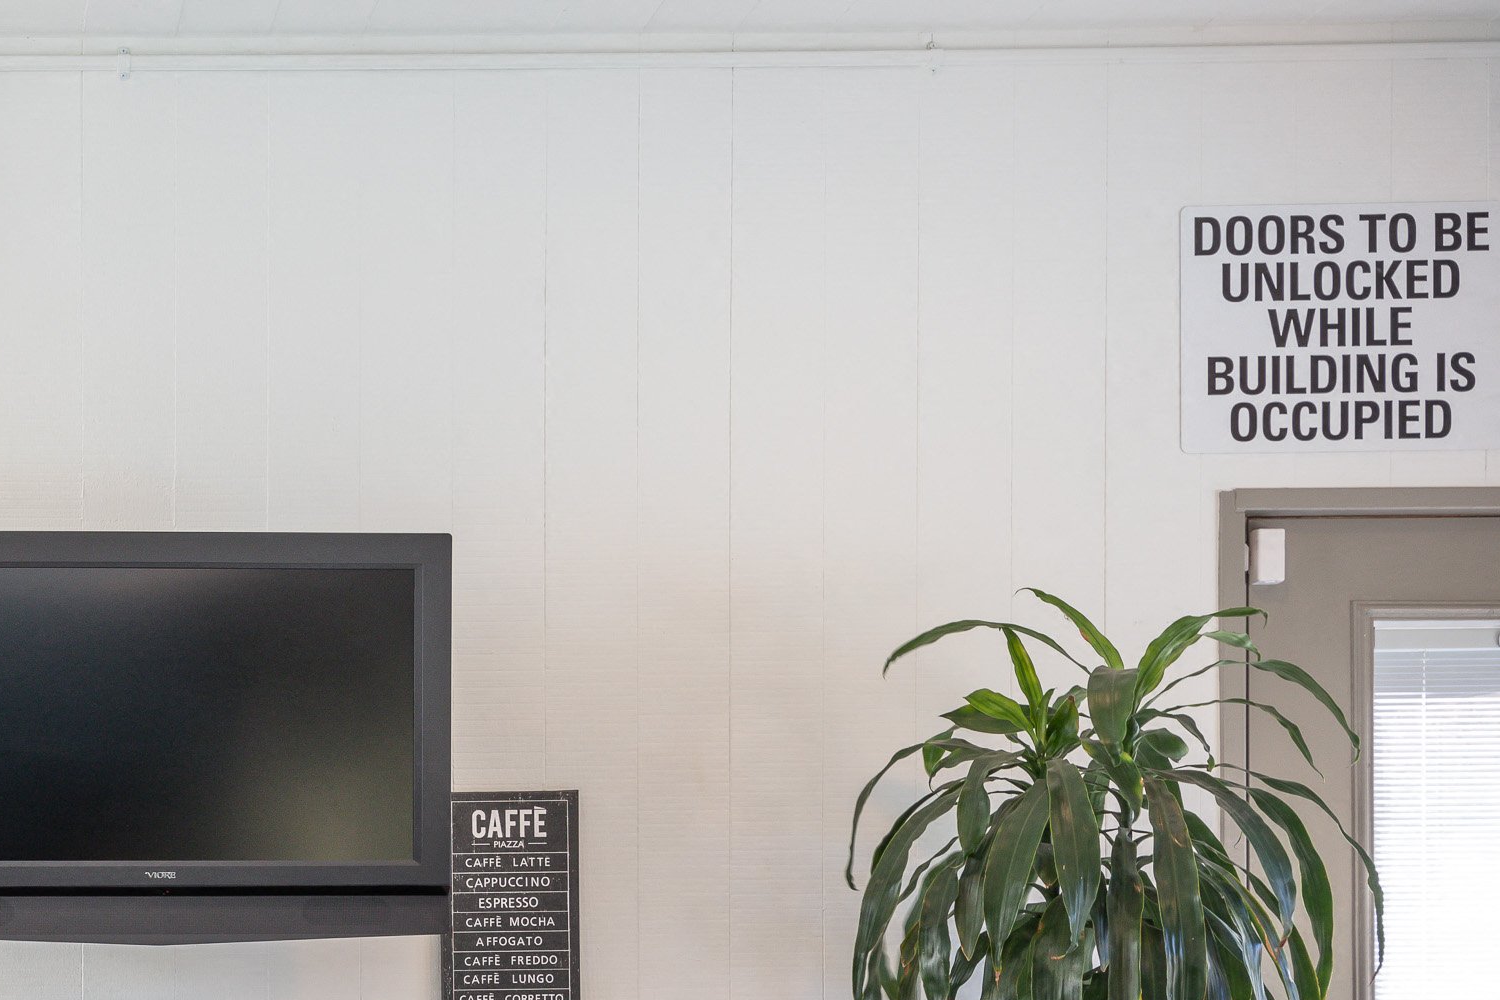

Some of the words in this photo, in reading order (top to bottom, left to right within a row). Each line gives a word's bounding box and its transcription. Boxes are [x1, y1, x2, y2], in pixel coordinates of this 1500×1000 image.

[1194, 214, 1345, 256] DOORS
[1359, 212, 1417, 253] TO
[1434, 212, 1490, 252] BE
[1222, 259, 1460, 302] UNLOCKED
[1268, 307, 1413, 348] WHILE
[1207, 353, 1418, 395] BUILDING
[1436, 352, 1476, 392] IS
[1230, 399, 1452, 442] OCCUPIED
[471, 806, 547, 839] CAFFÈ
[493, 840, 524, 848] PIAZZA
[465, 856, 501, 868] CAFFÈ
[513, 858, 550, 867] LATTE
[466, 876, 550, 888] CAPPUCCINO
[478, 897, 538, 909] ESPRESSO
[465, 915, 501, 927] CAFFÈ
[509, 916, 555, 927] MOCHA
[476, 936, 543, 946] AFFOGATO
[464, 954, 500, 966] CAFFÈ
[511, 955, 558, 965] FREDDO
[463, 973, 500, 985] CAFFÈ
[512, 973, 554, 984] LUNGO
